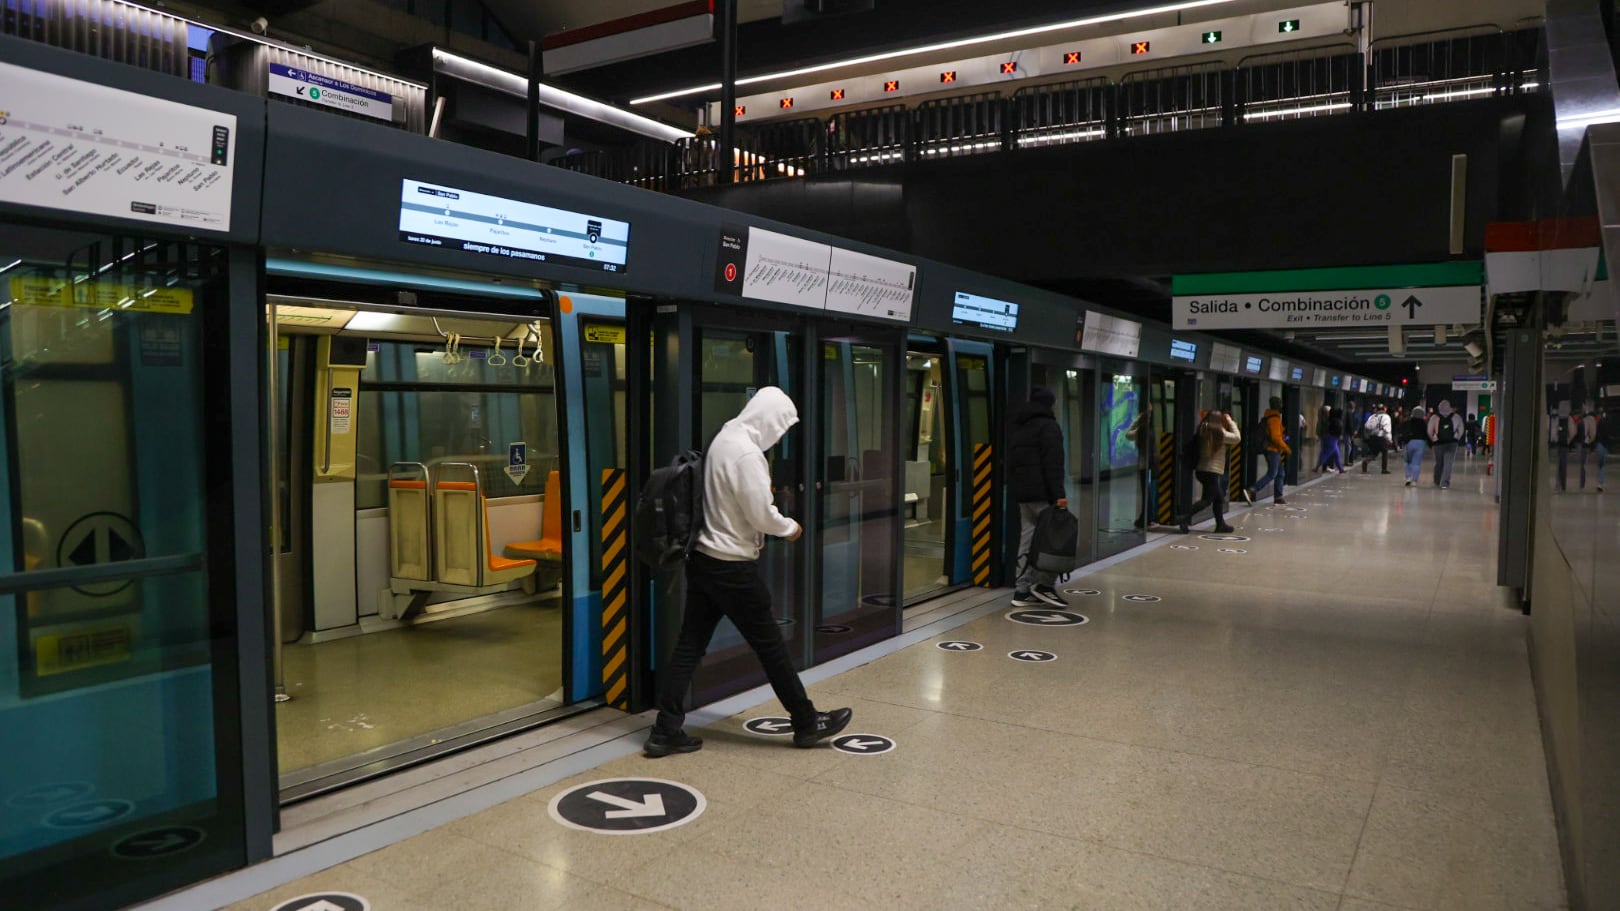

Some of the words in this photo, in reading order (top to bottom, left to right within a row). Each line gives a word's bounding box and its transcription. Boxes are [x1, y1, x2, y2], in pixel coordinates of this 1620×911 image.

[339, 81, 350, 89] Los
[321, 90, 369, 107] Combinación
[463, 243, 490, 253] siempre
[500, 247, 510, 255] los
[510, 250, 546, 261] pasamanos
[1189, 299, 1238, 314] Salida
[1258, 296, 1370, 312] Combinación
[1287, 314, 1303, 322] Exit
[1314, 313, 1349, 322] Transfer
[1352, 313, 1361, 321] to
[1363, 313, 1383, 321] Line
[1385, 312, 1392, 320] 5
